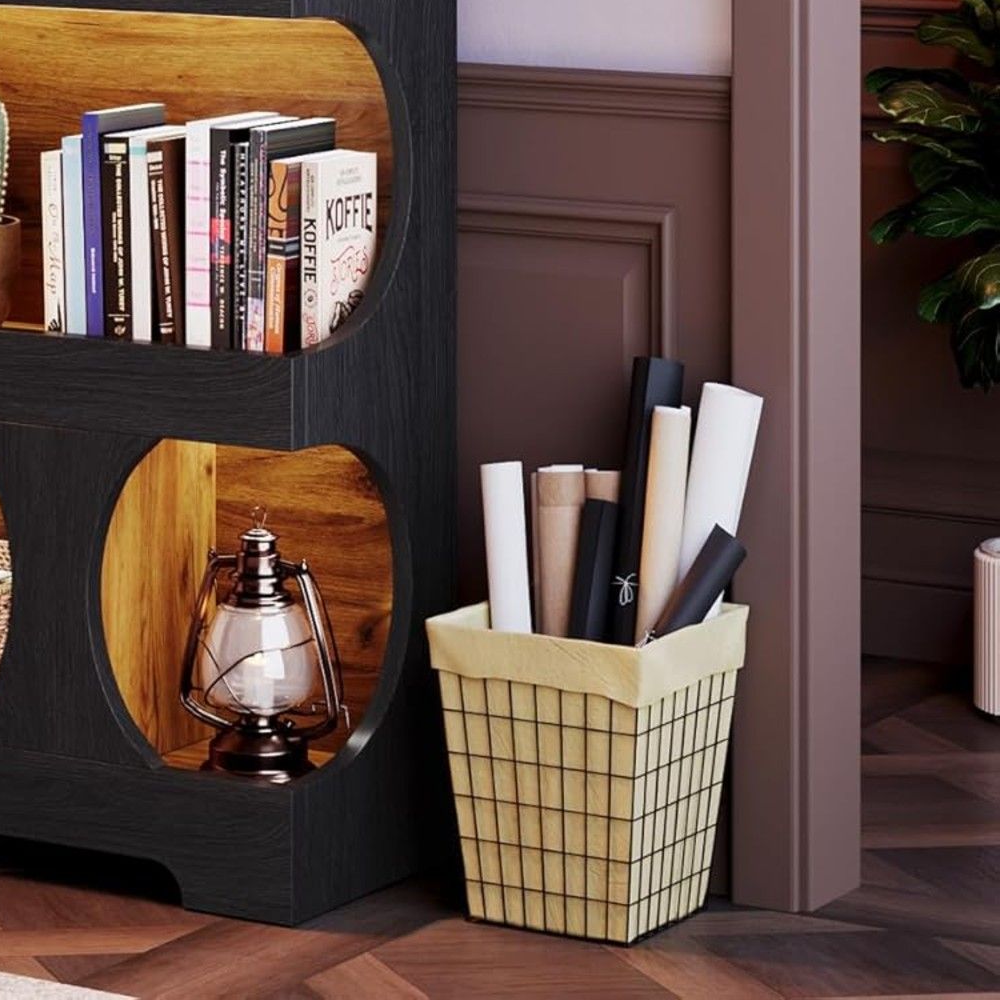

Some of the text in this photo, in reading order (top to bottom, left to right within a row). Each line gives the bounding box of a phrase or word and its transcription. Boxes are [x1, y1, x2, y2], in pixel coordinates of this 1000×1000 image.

[219, 150, 227, 165] The
[219, 168, 227, 206] Symbolic
[326, 193, 373, 240] KOFFIE
[304, 218, 317, 283] KOFFIE
